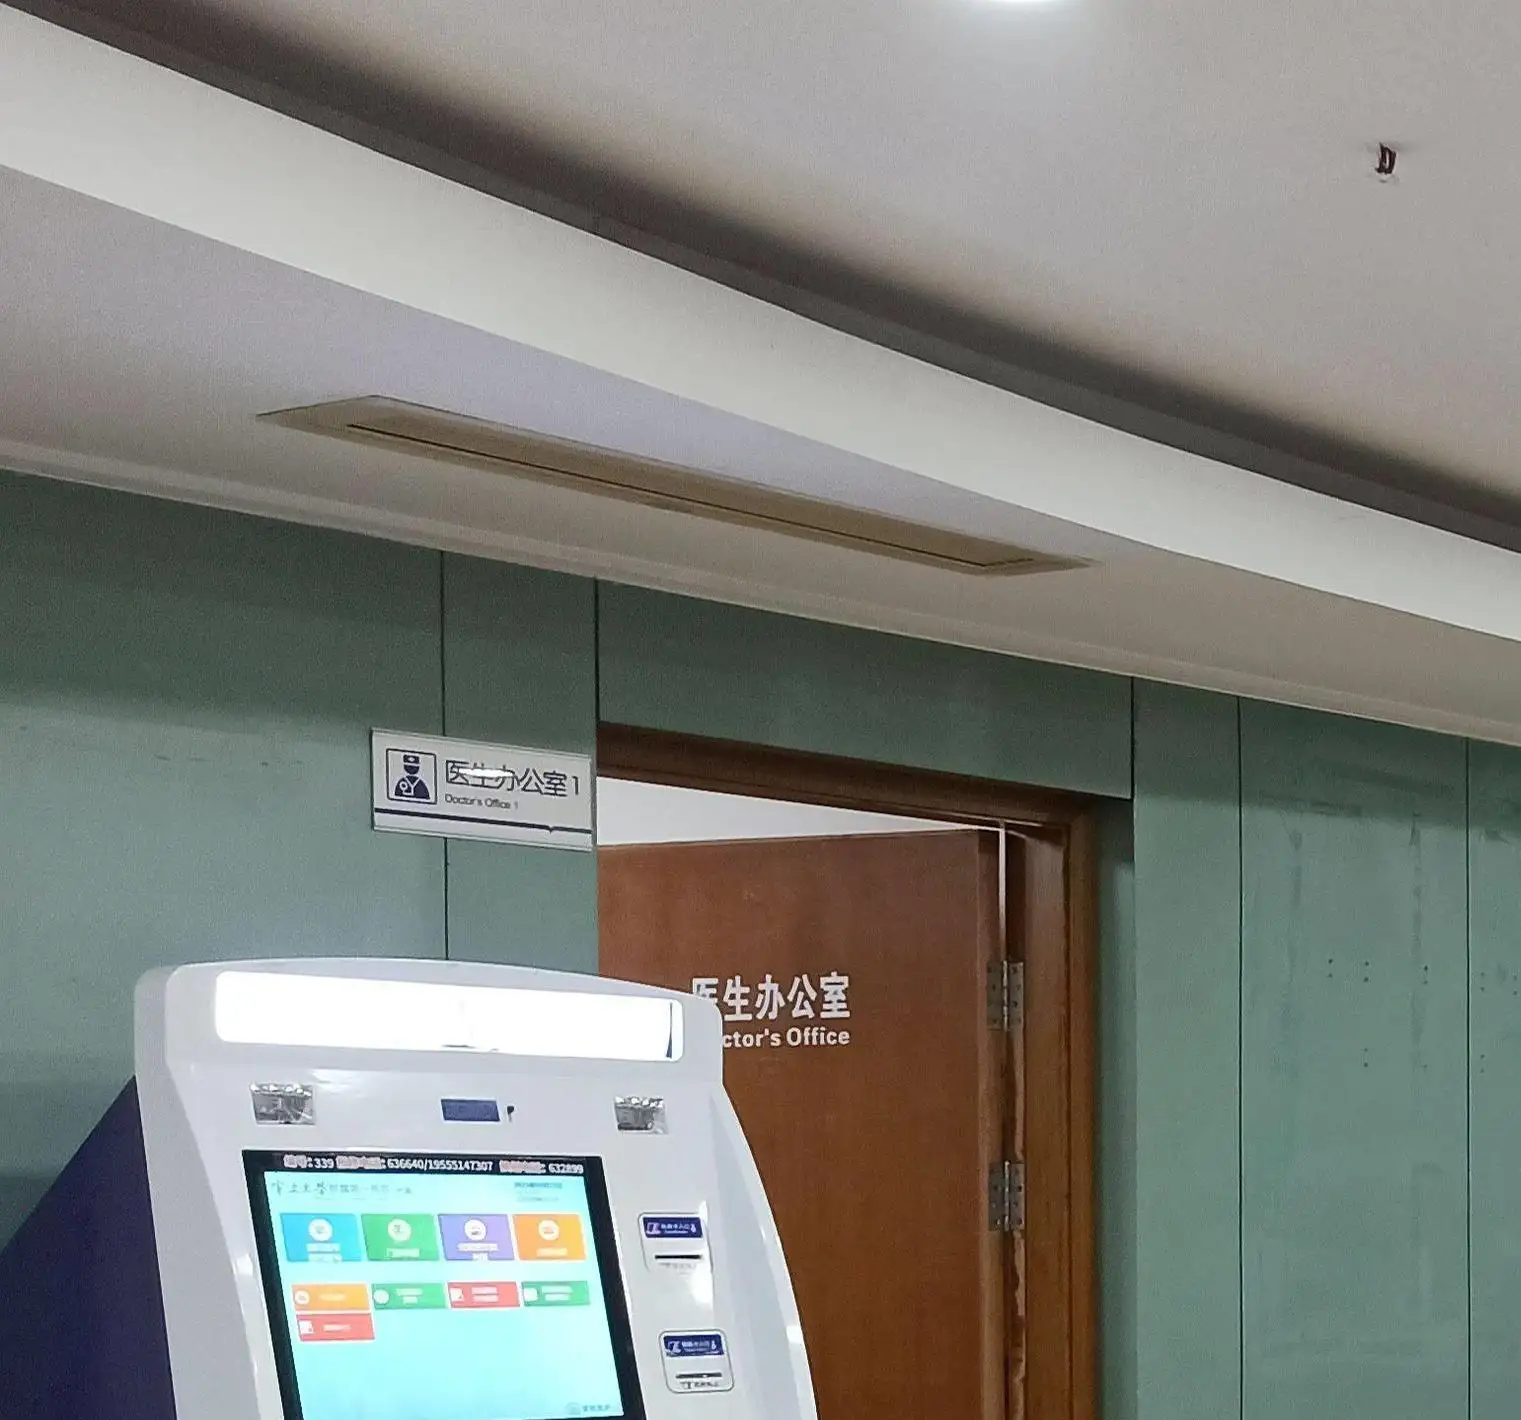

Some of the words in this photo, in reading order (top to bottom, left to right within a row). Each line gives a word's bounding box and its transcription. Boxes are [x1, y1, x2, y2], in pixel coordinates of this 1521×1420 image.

[691, 970, 851, 1021] 医生办公室
[722, 1027, 781, 1048] ctor's
[786, 1026, 850, 1047] Office
